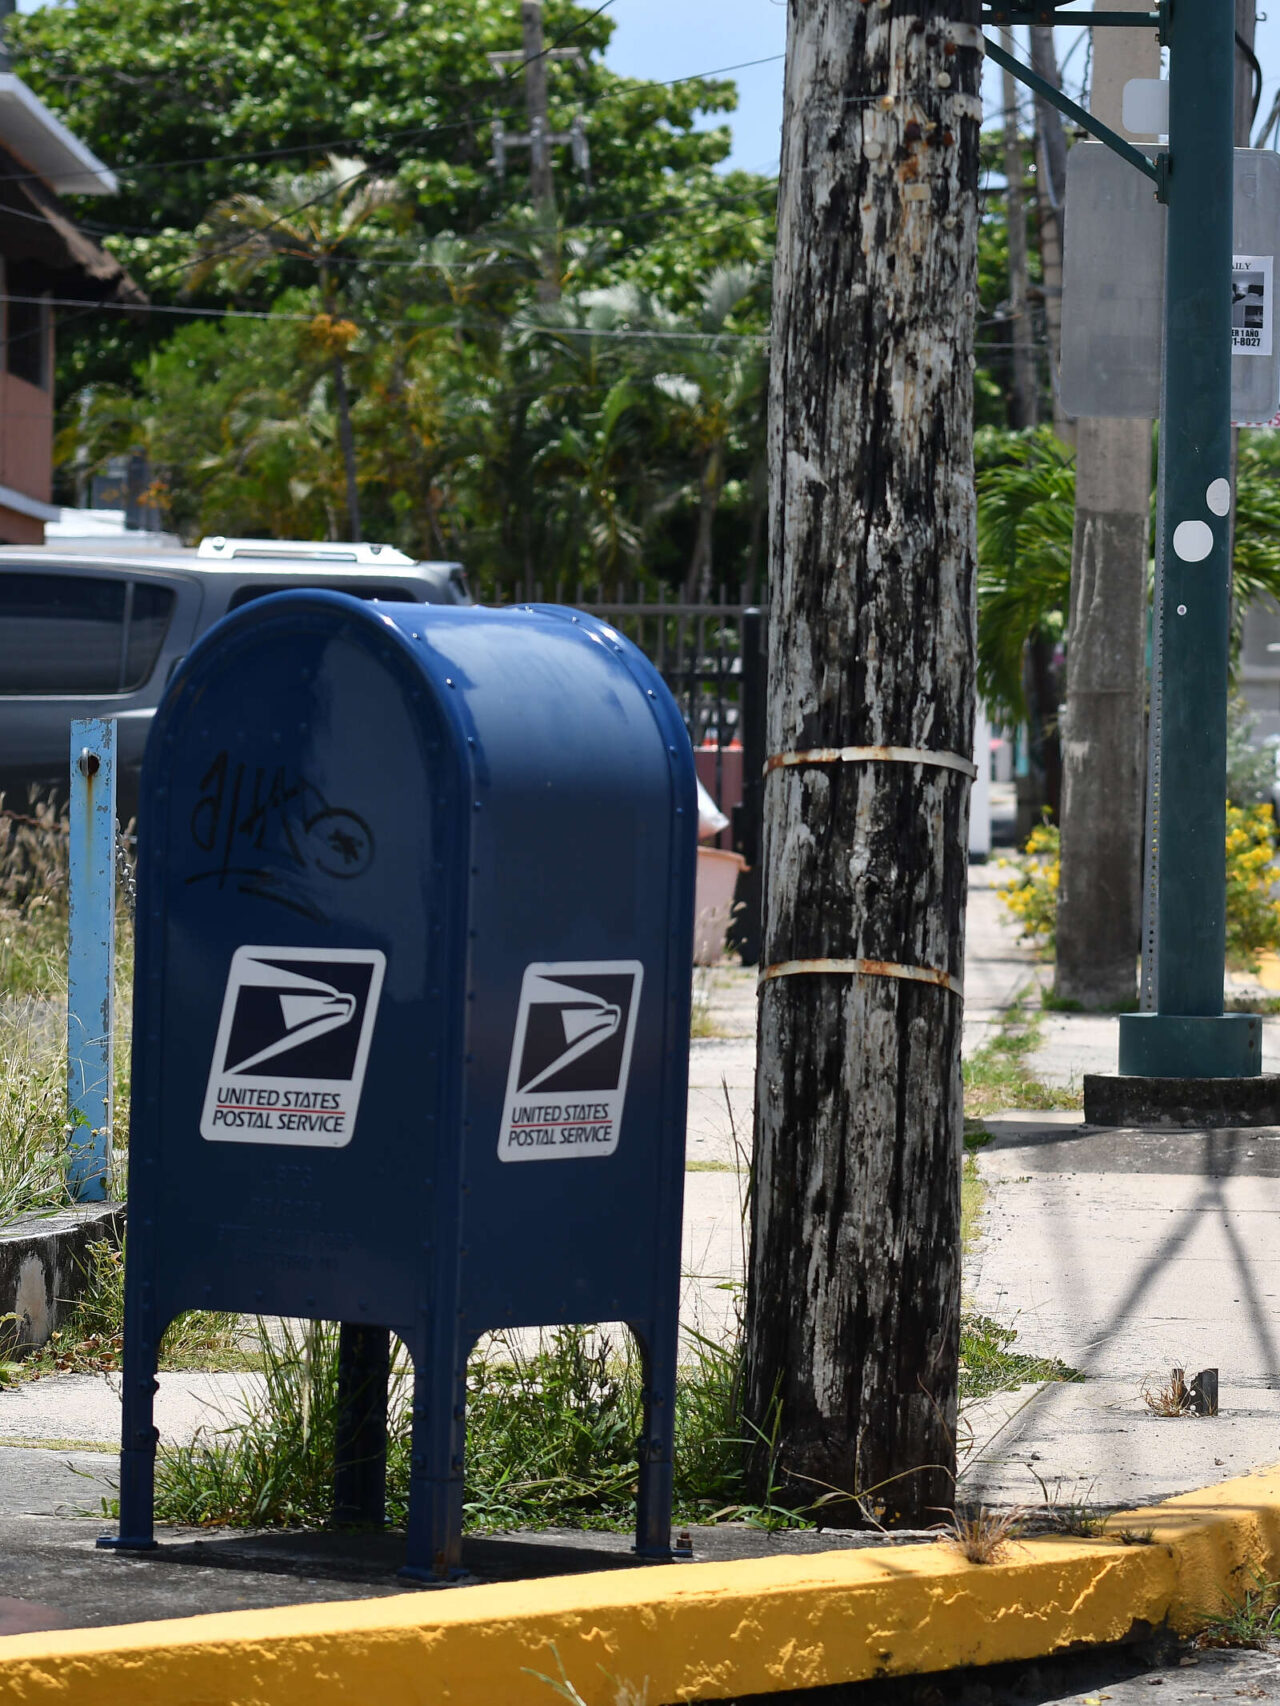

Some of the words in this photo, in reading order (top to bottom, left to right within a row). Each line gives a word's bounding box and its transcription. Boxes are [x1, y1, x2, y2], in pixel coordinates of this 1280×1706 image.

[1232, 262, 1252, 270] ILY
[1231, 329, 1239, 337] ER
[1245, 328, 1259, 338] AÑO
[1232, 337, 1261, 347] 1-8027
[217, 1087, 280, 1106] UNITED
[281, 1090, 341, 1109] STATES
[212, 1110, 273, 1129] POSTAL
[276, 1113, 345, 1133] SERVICE
[512, 1106, 561, 1123] UNITED
[564, 1104, 608, 1120] STATES
[508, 1130, 556, 1146] POSTAL
[559, 1126, 612, 1143] SERVICE
